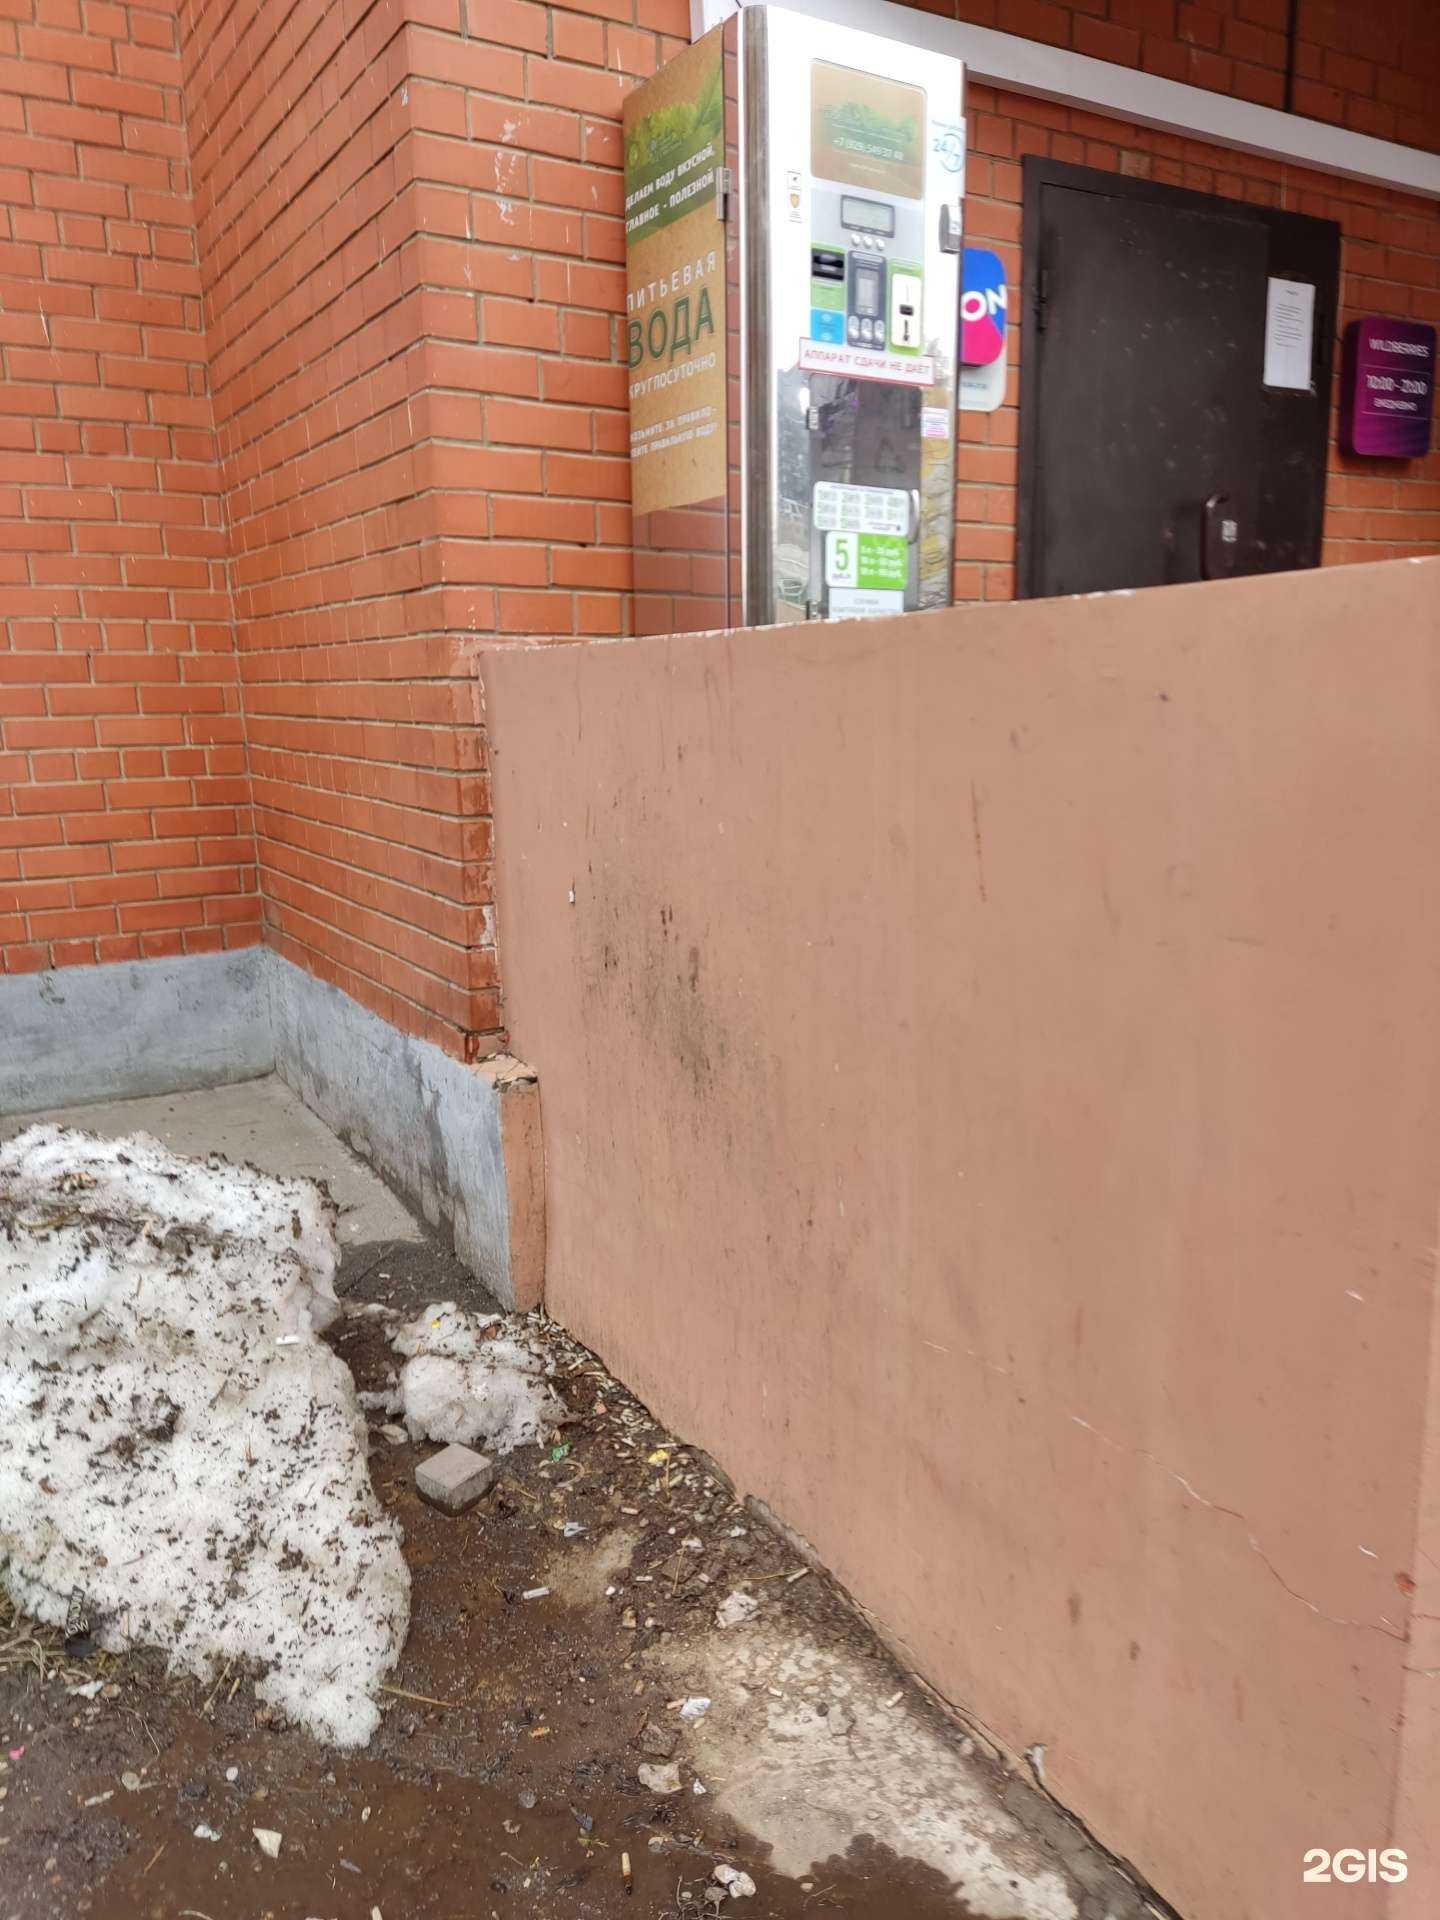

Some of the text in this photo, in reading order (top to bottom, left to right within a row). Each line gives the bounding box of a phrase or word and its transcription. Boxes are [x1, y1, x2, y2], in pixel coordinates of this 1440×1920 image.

[625, 182, 654, 212] ДЕЛАЕМ
[655, 168, 675, 190] ВОДУ
[626, 204, 660, 232] ГЛАВНОЕ
[669, 167, 714, 207] ПОЛЕЗНОЙ
[627, 250, 716, 313] ПИТЬЕВАЯ
[628, 287, 714, 368] ВОДА
[804, 350, 850, 363] АППАРАТ
[855, 356, 886, 368] СДАЧИ
[889, 361, 902, 371] НЕ
[836, 539, 849, 570] 5
